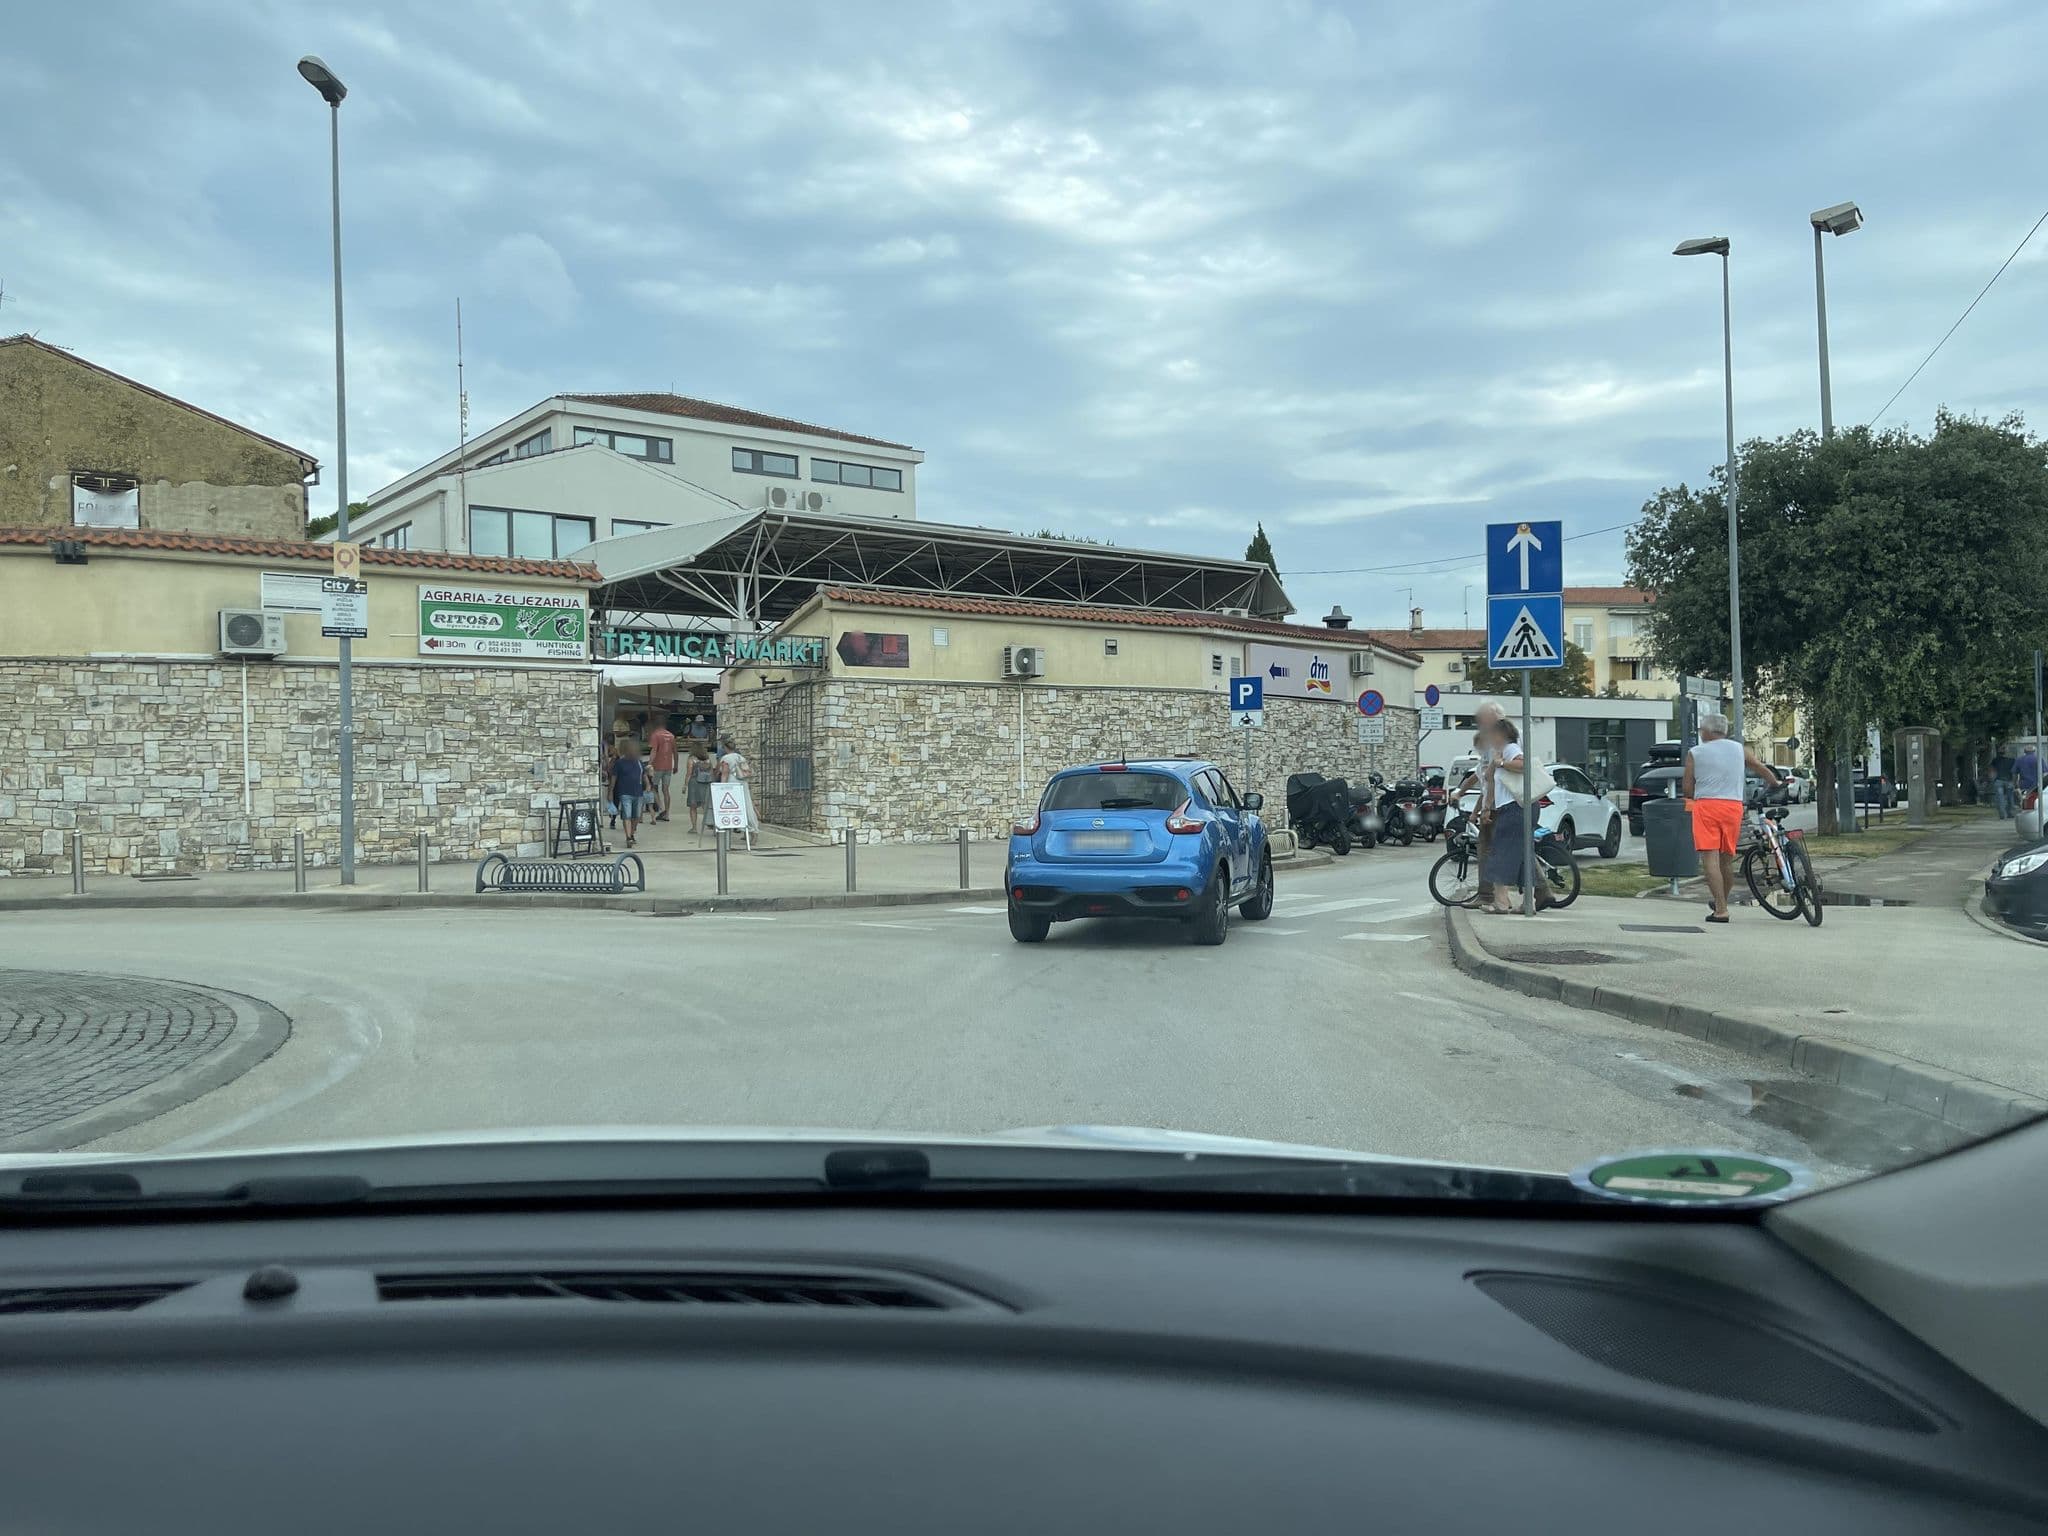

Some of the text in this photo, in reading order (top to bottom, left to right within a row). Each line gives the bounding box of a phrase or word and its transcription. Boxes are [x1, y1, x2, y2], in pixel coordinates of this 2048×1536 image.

[323, 580, 350, 593] City
[424, 590, 486, 603] AGRARIA
[433, 613, 501, 626] RITOŠA
[445, 640, 466, 649] 30m
[536, 641, 574, 649] HUNTING
[601, 631, 721, 658] TRŽNICA
[735, 639, 823, 663] MARKT
[548, 648, 581, 657] FISHING
[1310, 655, 1329, 680] dm
[1239, 683, 1254, 705] P
